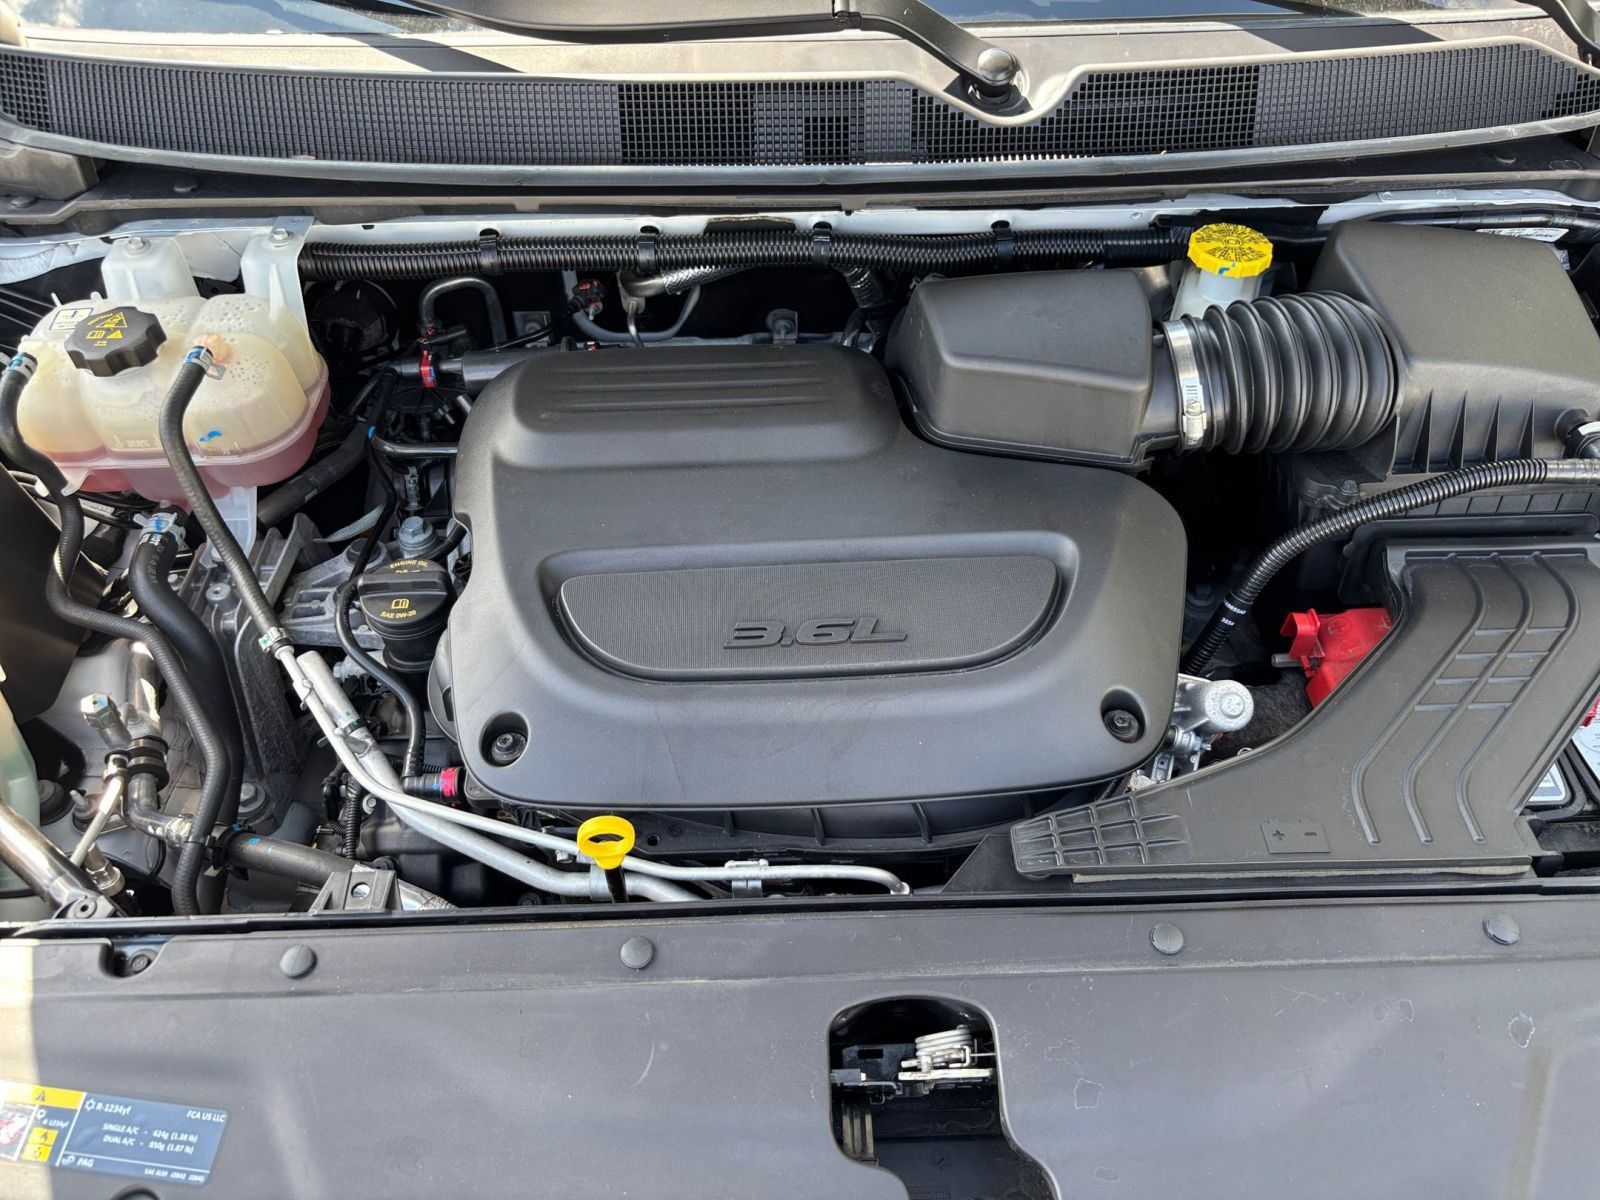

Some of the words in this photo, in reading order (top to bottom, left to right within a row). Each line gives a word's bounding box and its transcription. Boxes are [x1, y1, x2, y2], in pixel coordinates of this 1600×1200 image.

[389, 559, 418, 569] ENGINE
[380, 611, 395, 619] SAE
[395, 610, 417, 619] 0W-20
[723, 615, 908, 649] 3.6L
[95, 1102, 132, 1116] R-1234yf
[186, 1109, 201, 1120] FCA
[202, 1111, 212, 1121] US
[212, 1113, 226, 1123] LLC
[126, 1125, 140, 1136] A/C
[121, 1136, 136, 1147] A/C
[76, 1156, 95, 1169] PAG
